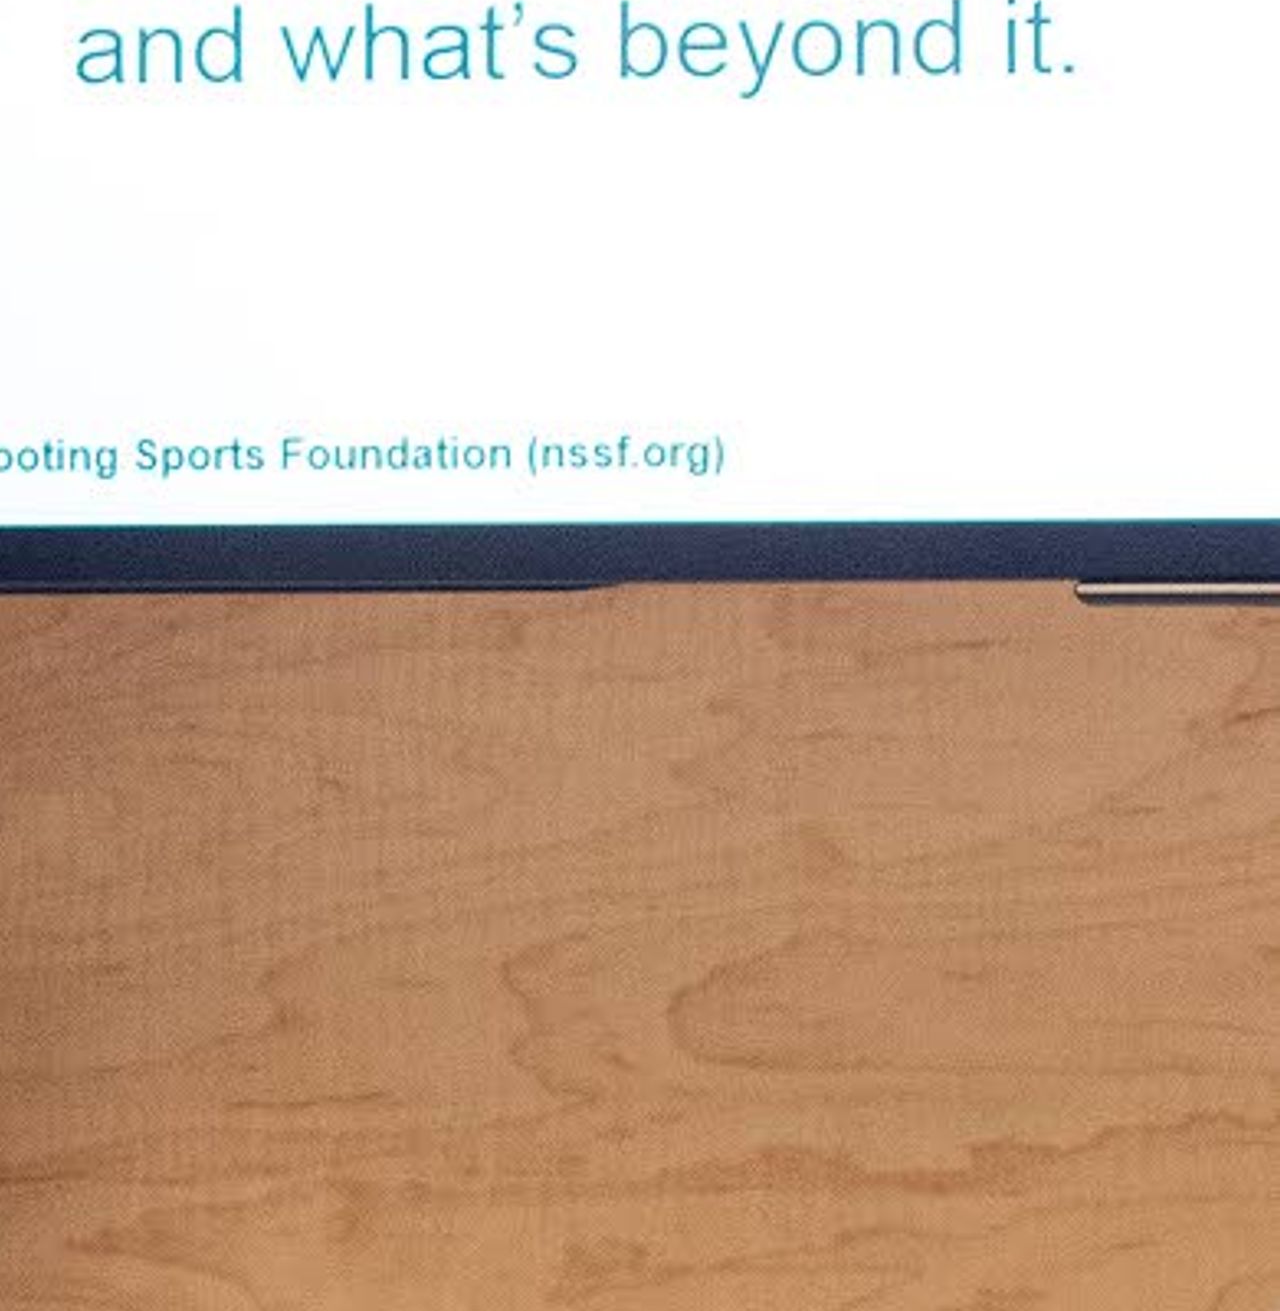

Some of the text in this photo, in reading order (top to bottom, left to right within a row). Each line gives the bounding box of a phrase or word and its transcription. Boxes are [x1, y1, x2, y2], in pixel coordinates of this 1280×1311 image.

[75, 4, 243, 85] and
[279, 0, 579, 83] what’s
[135, 438, 265, 479] Sports
[281, 436, 512, 471] Foundation
[527, 434, 725, 477] (nssf.org)
